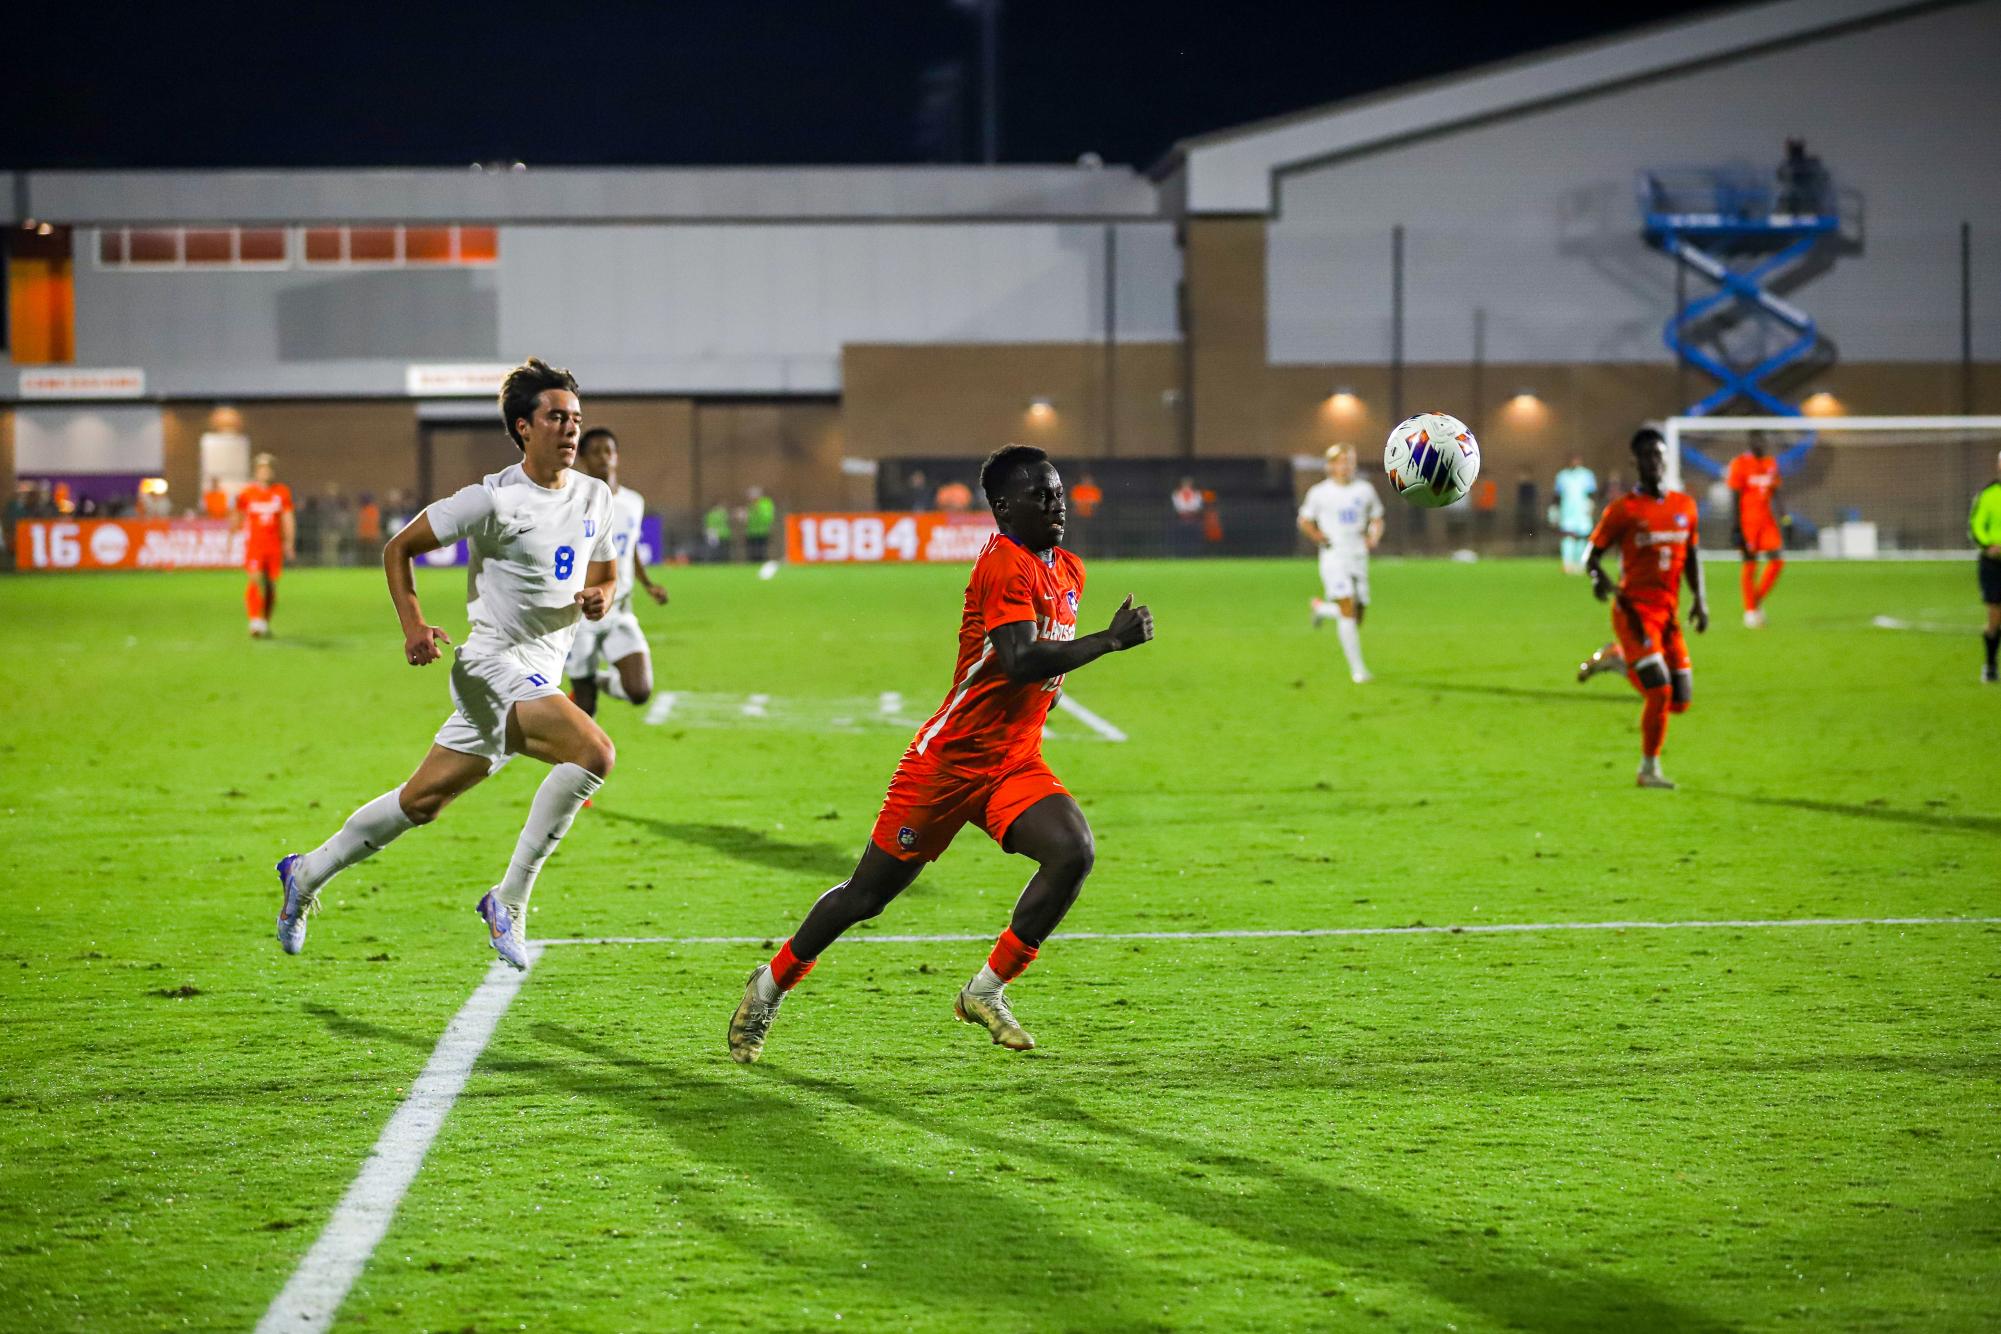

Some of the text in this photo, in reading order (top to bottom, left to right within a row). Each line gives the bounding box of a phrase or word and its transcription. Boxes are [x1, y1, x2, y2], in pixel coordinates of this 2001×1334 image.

[31, 523, 80, 567] 16
[800, 517, 918, 561] 1984
[554, 545, 575, 580] 8
